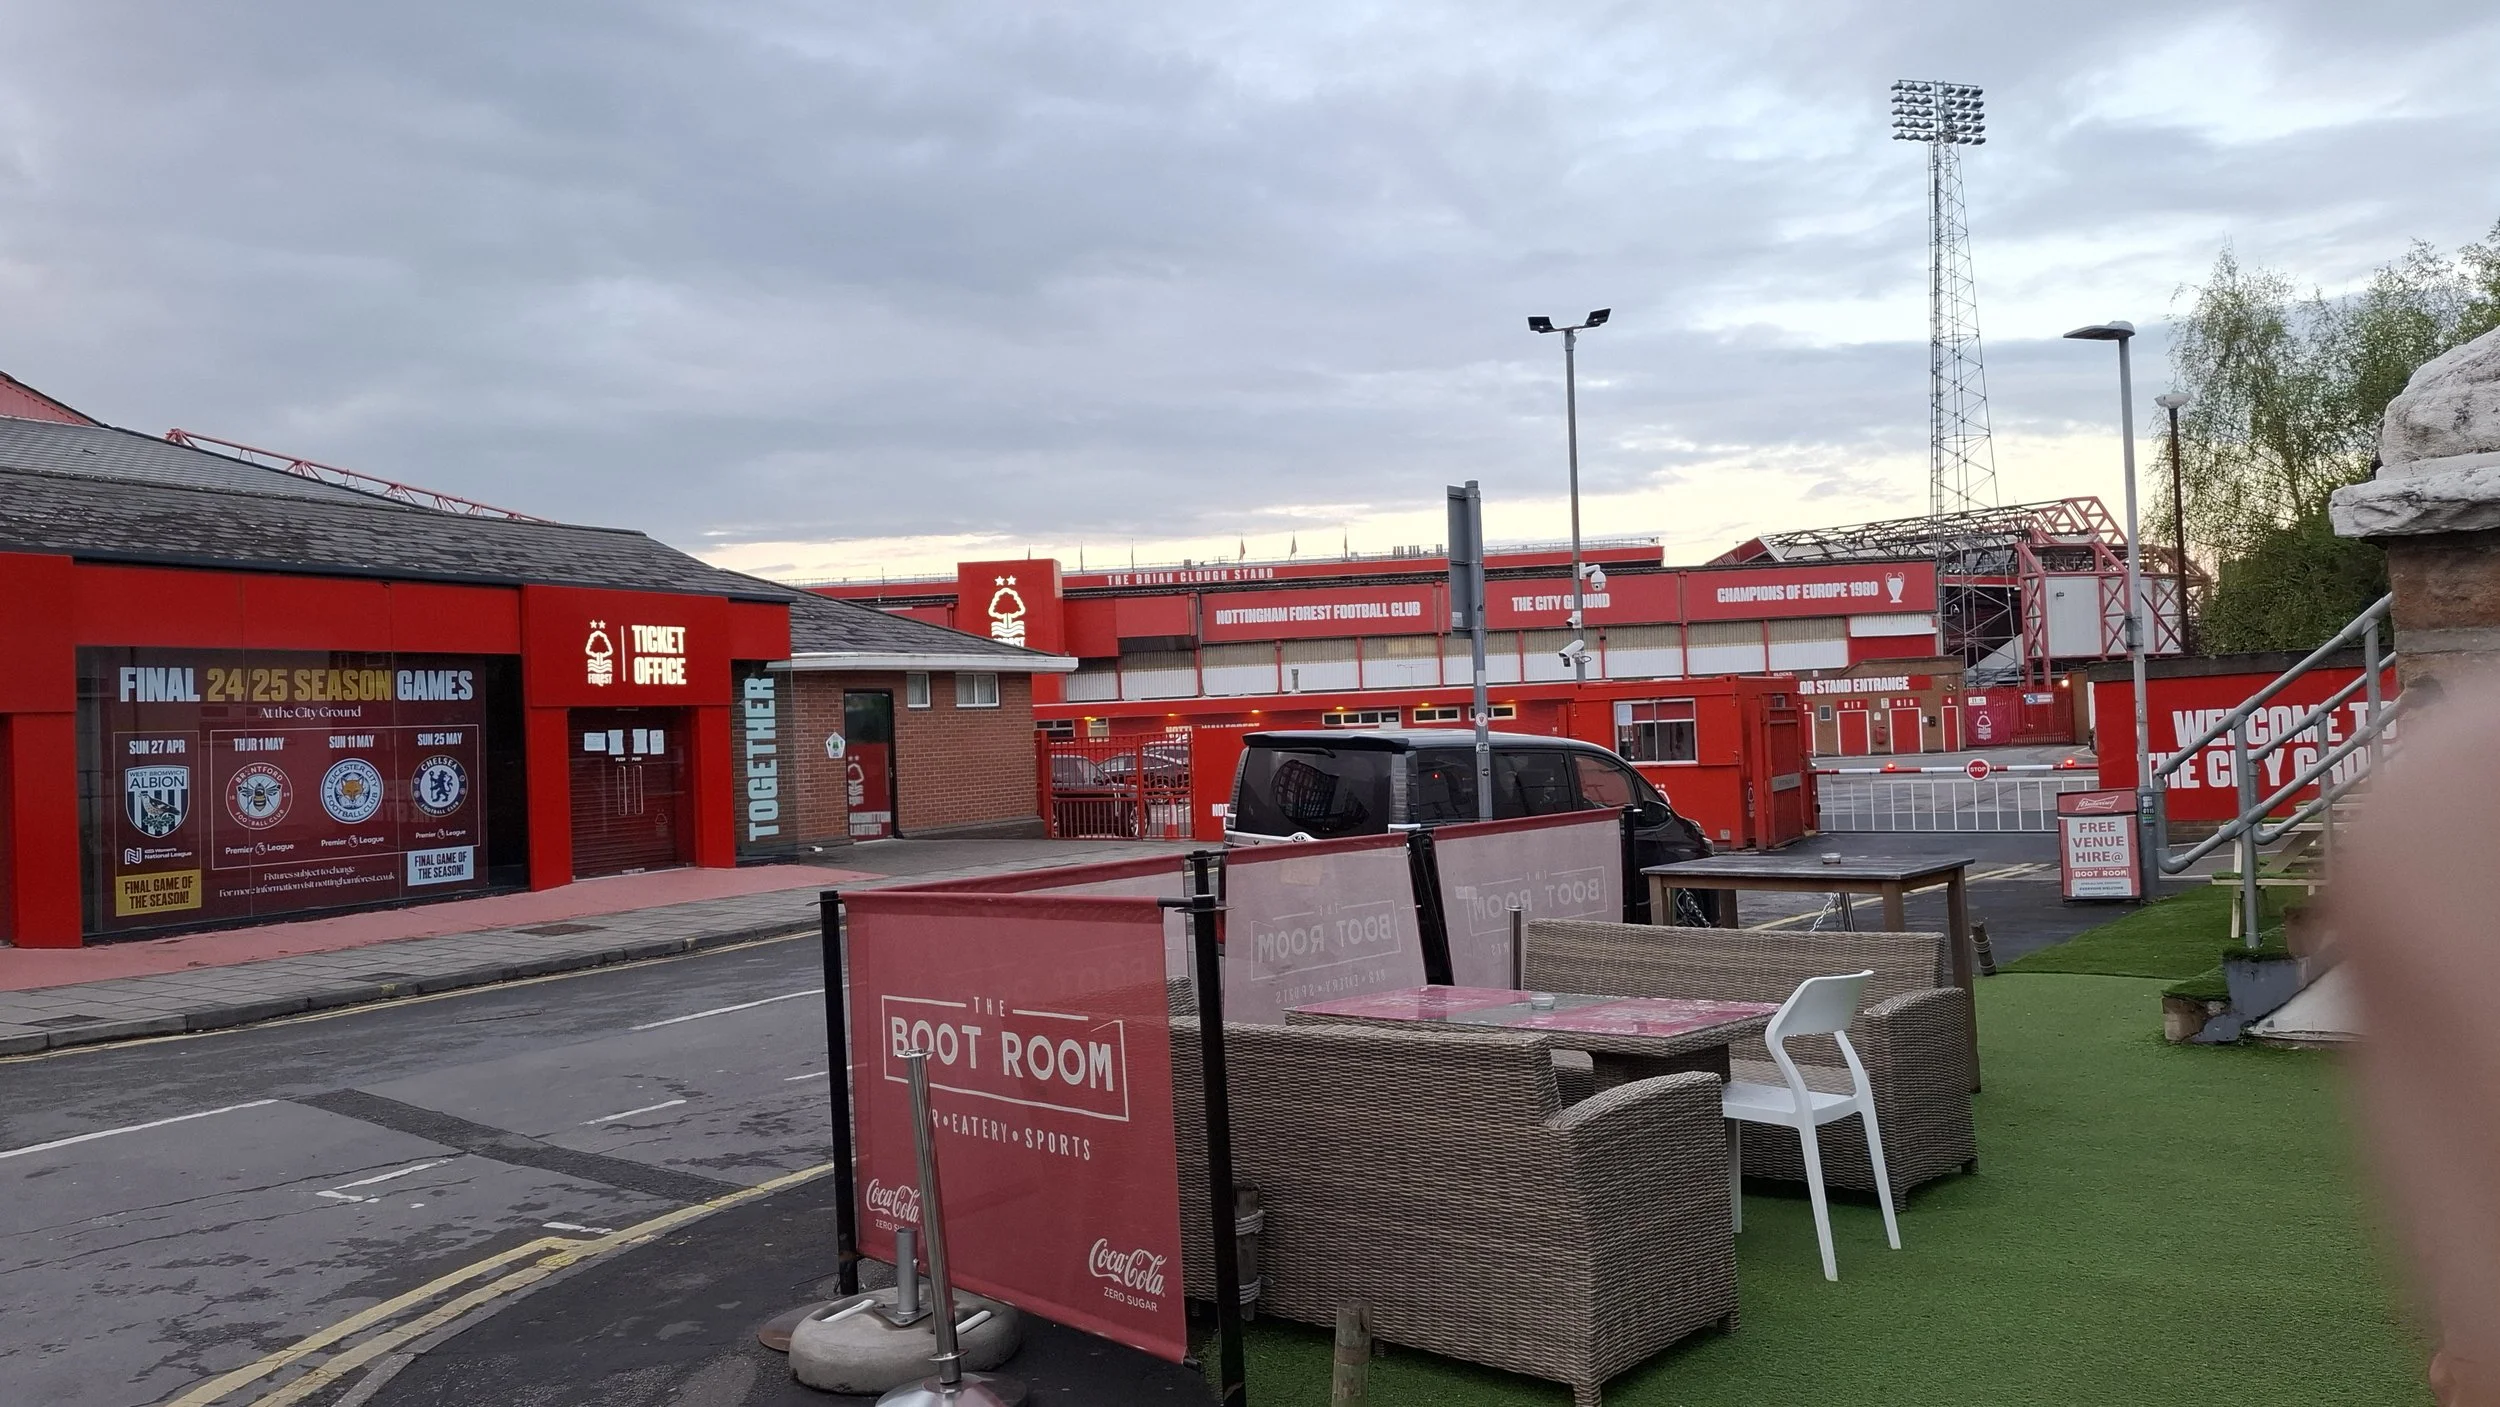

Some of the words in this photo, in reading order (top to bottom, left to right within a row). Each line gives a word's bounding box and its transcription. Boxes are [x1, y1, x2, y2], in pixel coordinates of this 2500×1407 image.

[1107, 575, 1129, 586] THE
[1136, 572, 1174, 585] BRIAN
[1180, 570, 1228, 583] CLOUGH
[1234, 567, 1274, 581] STAND
[1717, 585, 1785, 602] CHAMPIONS
[1786, 584, 1800, 600] OF
[1803, 583, 1848, 599] EUROPE
[1849, 581, 1878, 597] 1980
[1512, 596, 1534, 612] THE
[1535, 595, 1562, 611] CITY
[1216, 607, 1288, 624] NOTTINGHAM
[1290, 605, 1332, 622] FOREST
[1334, 603, 1389, 620] FOOTBALL
[1391, 601, 1420, 616] CLUB
[631, 625, 686, 654] TICKET
[634, 657, 687, 685] OFFICE
[120, 666, 200, 702] FINAL
[207, 668, 288, 702] 24/25
[294, 668, 392, 702] SEASON
[396, 670, 473, 701] GAMES
[1816, 679, 1852, 694] STAND
[1853, 676, 1910, 692] ENTRANCE
[260, 707, 273, 718] At
[275, 707, 294, 718] the
[295, 706, 317, 720] City
[319, 705, 361, 718] Ground
[129, 740, 149, 754] SUN
[151, 740, 164, 754] 27
[166, 739, 186, 753] APR
[259, 738, 264, 751] 1
[265, 737, 284, 750] MAY
[329, 736, 345, 748] SUN
[347, 735, 356, 748] 11
[357, 735, 374, 748] MAY
[417, 733, 433, 746] SUN
[434, 733, 446, 746] 25
[446, 732, 462, 744] MAY
[421, 757, 458, 772] CHELSEA
[744, 678, 780, 842] TOGETHER
[2207, 748, 2285, 788] CIY
[130, 776, 184, 789] ALBION
[327, 764, 366, 790] LEICESTER
[366, 770, 378, 788] CITY
[327, 794, 364, 818] FOOTBALL
[364, 792, 378, 813] CLUB
[415, 831, 436, 839] Premier
[445, 829, 466, 837] League
[2079, 821, 2116, 833] FREE
[225, 846, 254, 855] Premier
[267, 844, 294, 852] League
[321, 839, 346, 847] Premier
[360, 836, 385, 844] League
[2072, 836, 2124, 848] VENUE
[415, 854, 435, 868] FINAL
[436, 852, 457, 865] GAME
[458, 851, 467, 863] OF
[2076, 851, 2124, 863] HIRE@
[294, 869, 320, 880] subject
[418, 868, 432, 880] THE
[433, 864, 464, 879] SEASON!
[2075, 870, 2098, 878] BOOT
[124, 879, 151, 894] FINAL
[153, 877, 180, 892] GAME
[181, 876, 193, 889] OF
[129, 895, 148, 910] THE
[149, 891, 189, 907] SEASON!
[973, 996, 1006, 1018] THE
[891, 1016, 982, 1070] BOOT
[1001, 1031, 1114, 1092] ROOM
[952, 1113, 1007, 1144] EATERY
[1025, 1128, 1090, 1161] SPORTS
[876, 1219, 893, 1231] ZERO
[1104, 1287, 1125, 1302] ZERO
[1127, 1295, 1158, 1313] SUGAR
